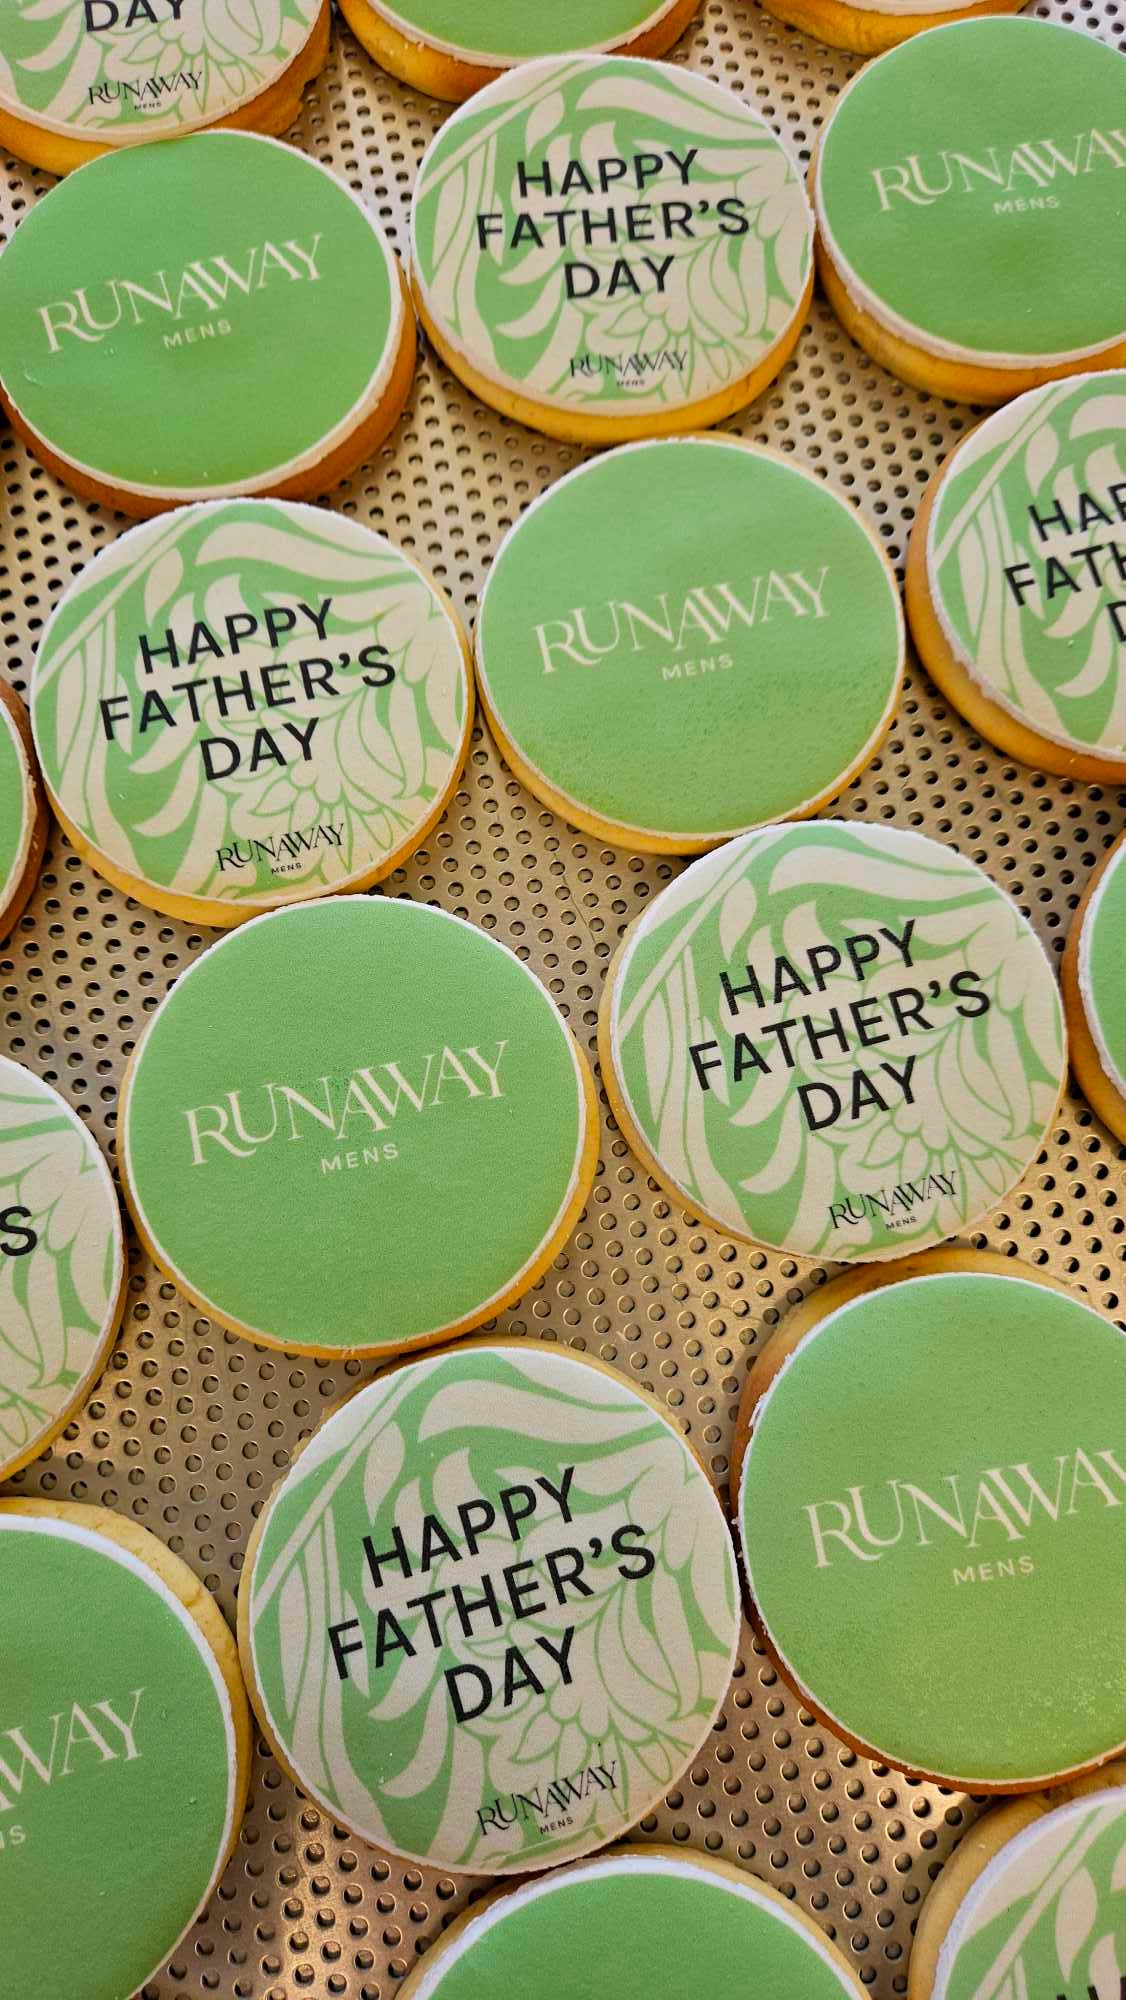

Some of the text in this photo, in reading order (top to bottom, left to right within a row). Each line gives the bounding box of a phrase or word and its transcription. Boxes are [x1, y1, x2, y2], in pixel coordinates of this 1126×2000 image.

[88, 71, 203, 104] RUNAWAY
[517, 148, 699, 198] HAPPY
[476, 198, 750, 250] FATHER'S
[993, 196, 1059, 214] MENS
[36, 233, 324, 354] RUNAWAY
[563, 255, 676, 299] DAY
[162, 319, 232, 350] MENS
[569, 350, 688, 378] RUNAWAY
[139, 598, 332, 674] HAPPY
[535, 567, 830, 673] RUNAWAY
[99, 644, 395, 741] FATHER'S
[661, 653, 734, 682] MENS
[200, 717, 320, 781] DAY
[215, 822, 345, 872] RUNAWAY
[719, 919, 916, 1017] HAPPY
[688, 970, 991, 1092] FATHER'S
[181, 1041, 509, 1166] RUNAWAY
[796, 1054, 917, 1131] DAY
[320, 1143, 399, 1175] MENS
[827, 1169, 957, 1230] RUNAWAY
[885, 1215, 917, 1231] MENS
[362, 1465, 576, 1589] HAPPY
[953, 1556, 1036, 1585] MENS
[328, 1523, 656, 1681] FATHER'S
[444, 1625, 576, 1724] DAY
[0, 1686, 147, 1812] WAY
[475, 1760, 617, 1836] RUNAWAY
[539, 1815, 574, 1835] MENS
